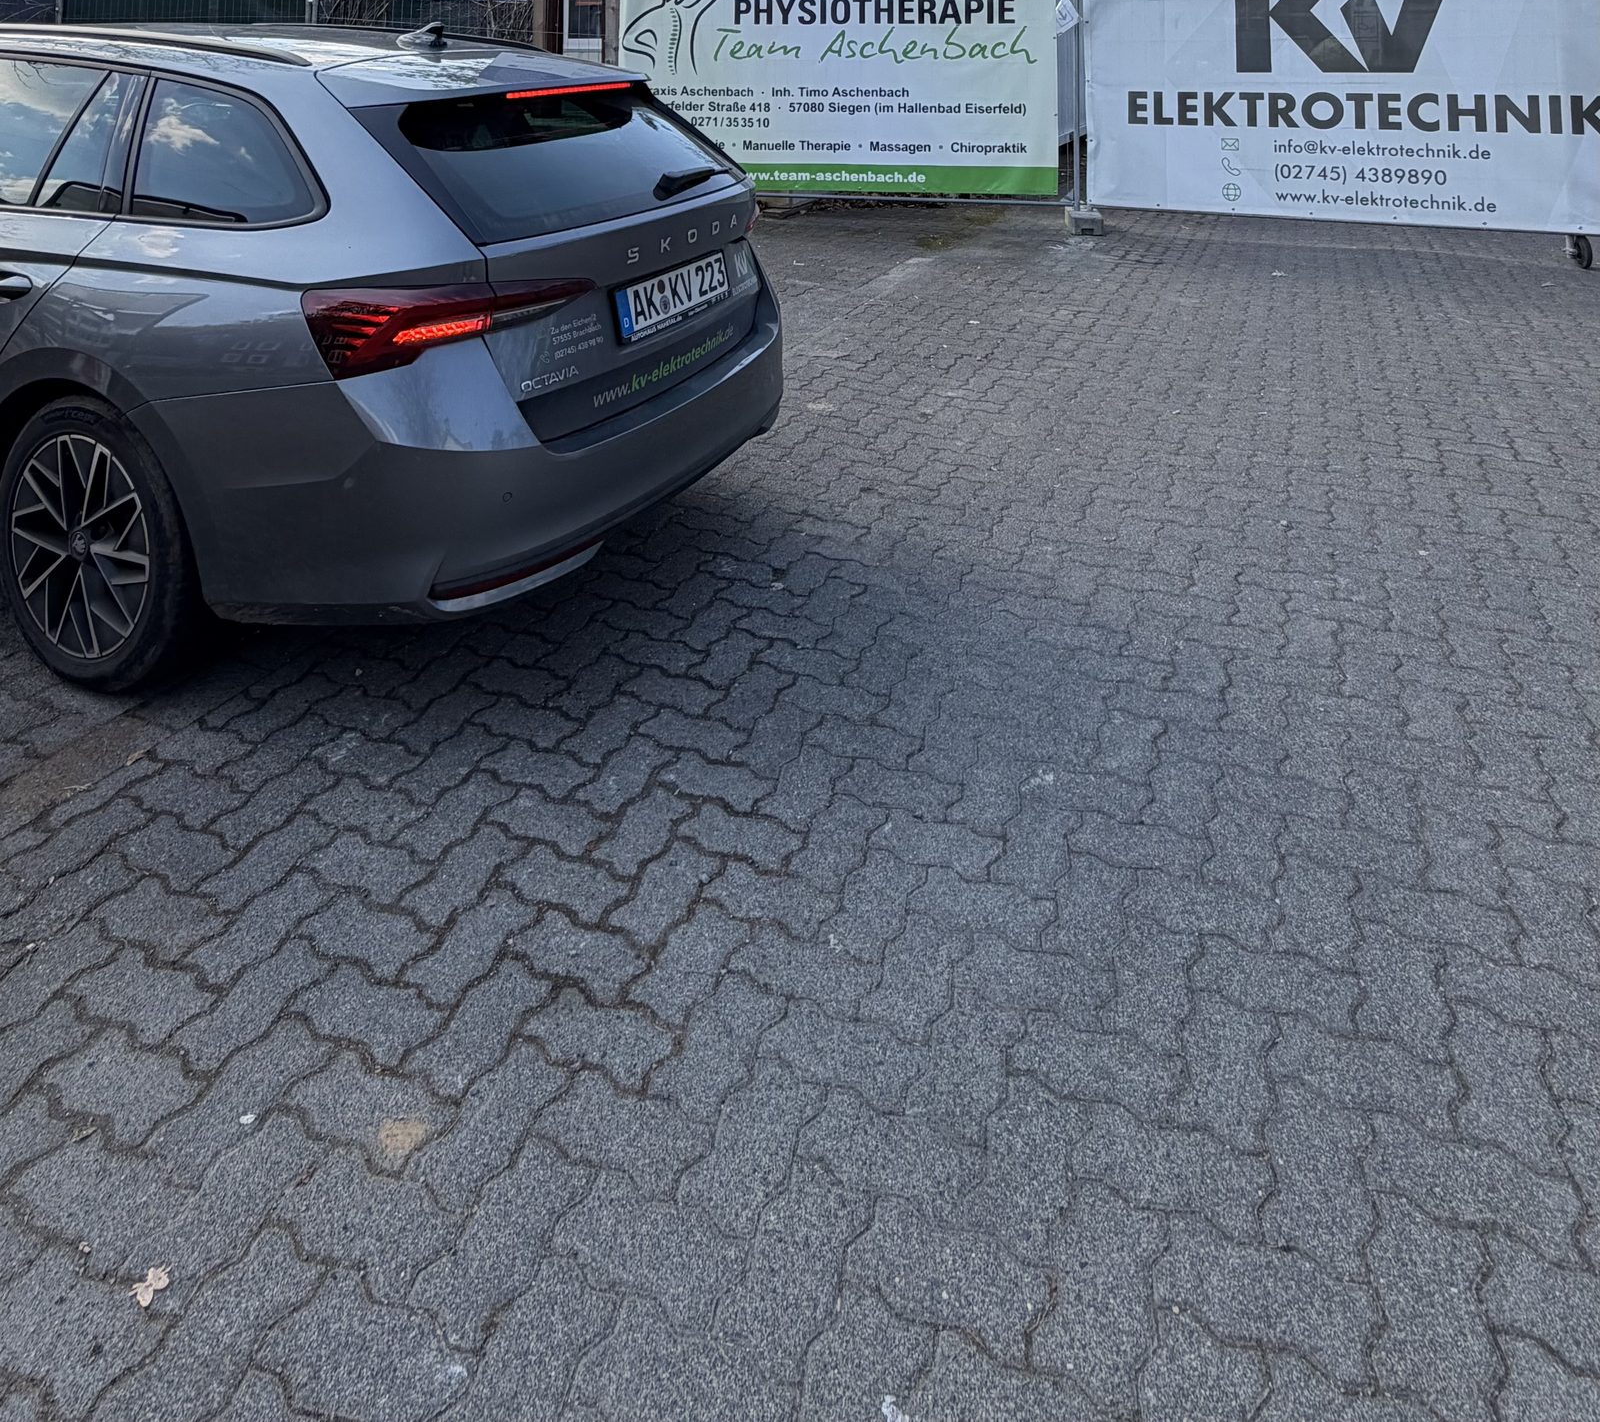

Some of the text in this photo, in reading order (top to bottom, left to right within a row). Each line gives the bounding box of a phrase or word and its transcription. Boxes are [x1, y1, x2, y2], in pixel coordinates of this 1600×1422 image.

[713, 25, 1038, 64] Team Aschenbach
[680, 85, 754, 98] Aschenbach
[771, 87, 795, 98] Inh.
[799, 87, 829, 98] Timo
[832, 86, 910, 98] Aschenbach
[708, 101, 746, 113] Straße
[749, 102, 771, 113] 418
[788, 102, 825, 114] 57080
[828, 102, 871, 116] Siegen
[874, 102, 894, 116] (im
[897, 102, 961, 115] Hallenbad
[965, 103, 1027, 117] Eiserfeld)
[1127, 90, 1600, 135] ELEKTROTECHNIK
[742, 139, 796, 151] Manuelle
[799, 140, 851, 153] Therapie
[869, 141, 932, 155] Massagen
[950, 141, 1027, 156] Chiropraktik
[1273, 139, 1492, 160] info@kv-elektrotechnik.de
[746, 169, 927, 183] ww.team-aschenbach.de
[1274, 163, 1448, 186] (02745) 4389890
[1275, 189, 1498, 214] www.kv-elektrotechnik.de
[633, 283, 661, 326] AK
[668, 272, 693, 310] KV
[695, 257, 726, 298] 223
[623, 317, 630, 329] D
[593, 322, 734, 408] www.kv-elektrotechnik.de
[521, 365, 580, 393] OCTAVIA
